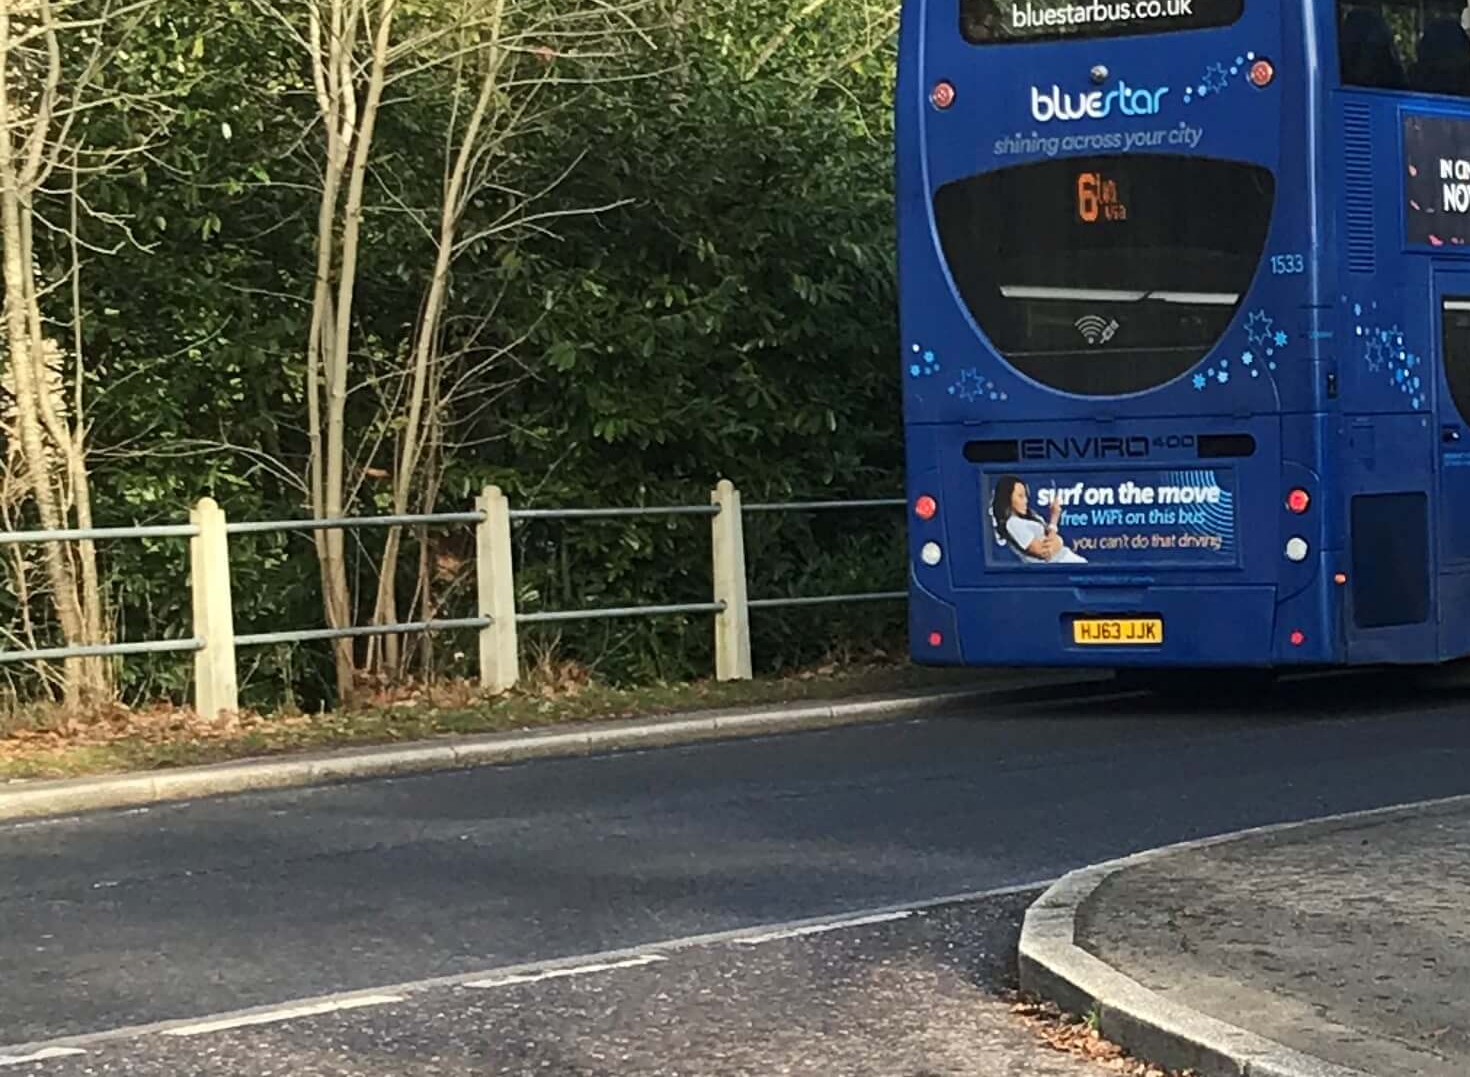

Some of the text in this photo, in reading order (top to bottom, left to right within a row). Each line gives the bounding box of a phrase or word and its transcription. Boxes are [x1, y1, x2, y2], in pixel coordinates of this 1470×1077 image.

[1030, 80, 1169, 122] bluestar
[993, 121, 1203, 157] shining across your city
[1439, 158, 1453, 180] IN
[1270, 253, 1304, 274] 1533
[1021, 436, 1150, 459] ENVIRO
[1037, 481, 1221, 506] surf on the move
[1060, 508, 1205, 527] free WiFi on this bus
[1072, 533, 1222, 551] you can't do that driving
[1080, 622, 1156, 640] HJ63 JJK
